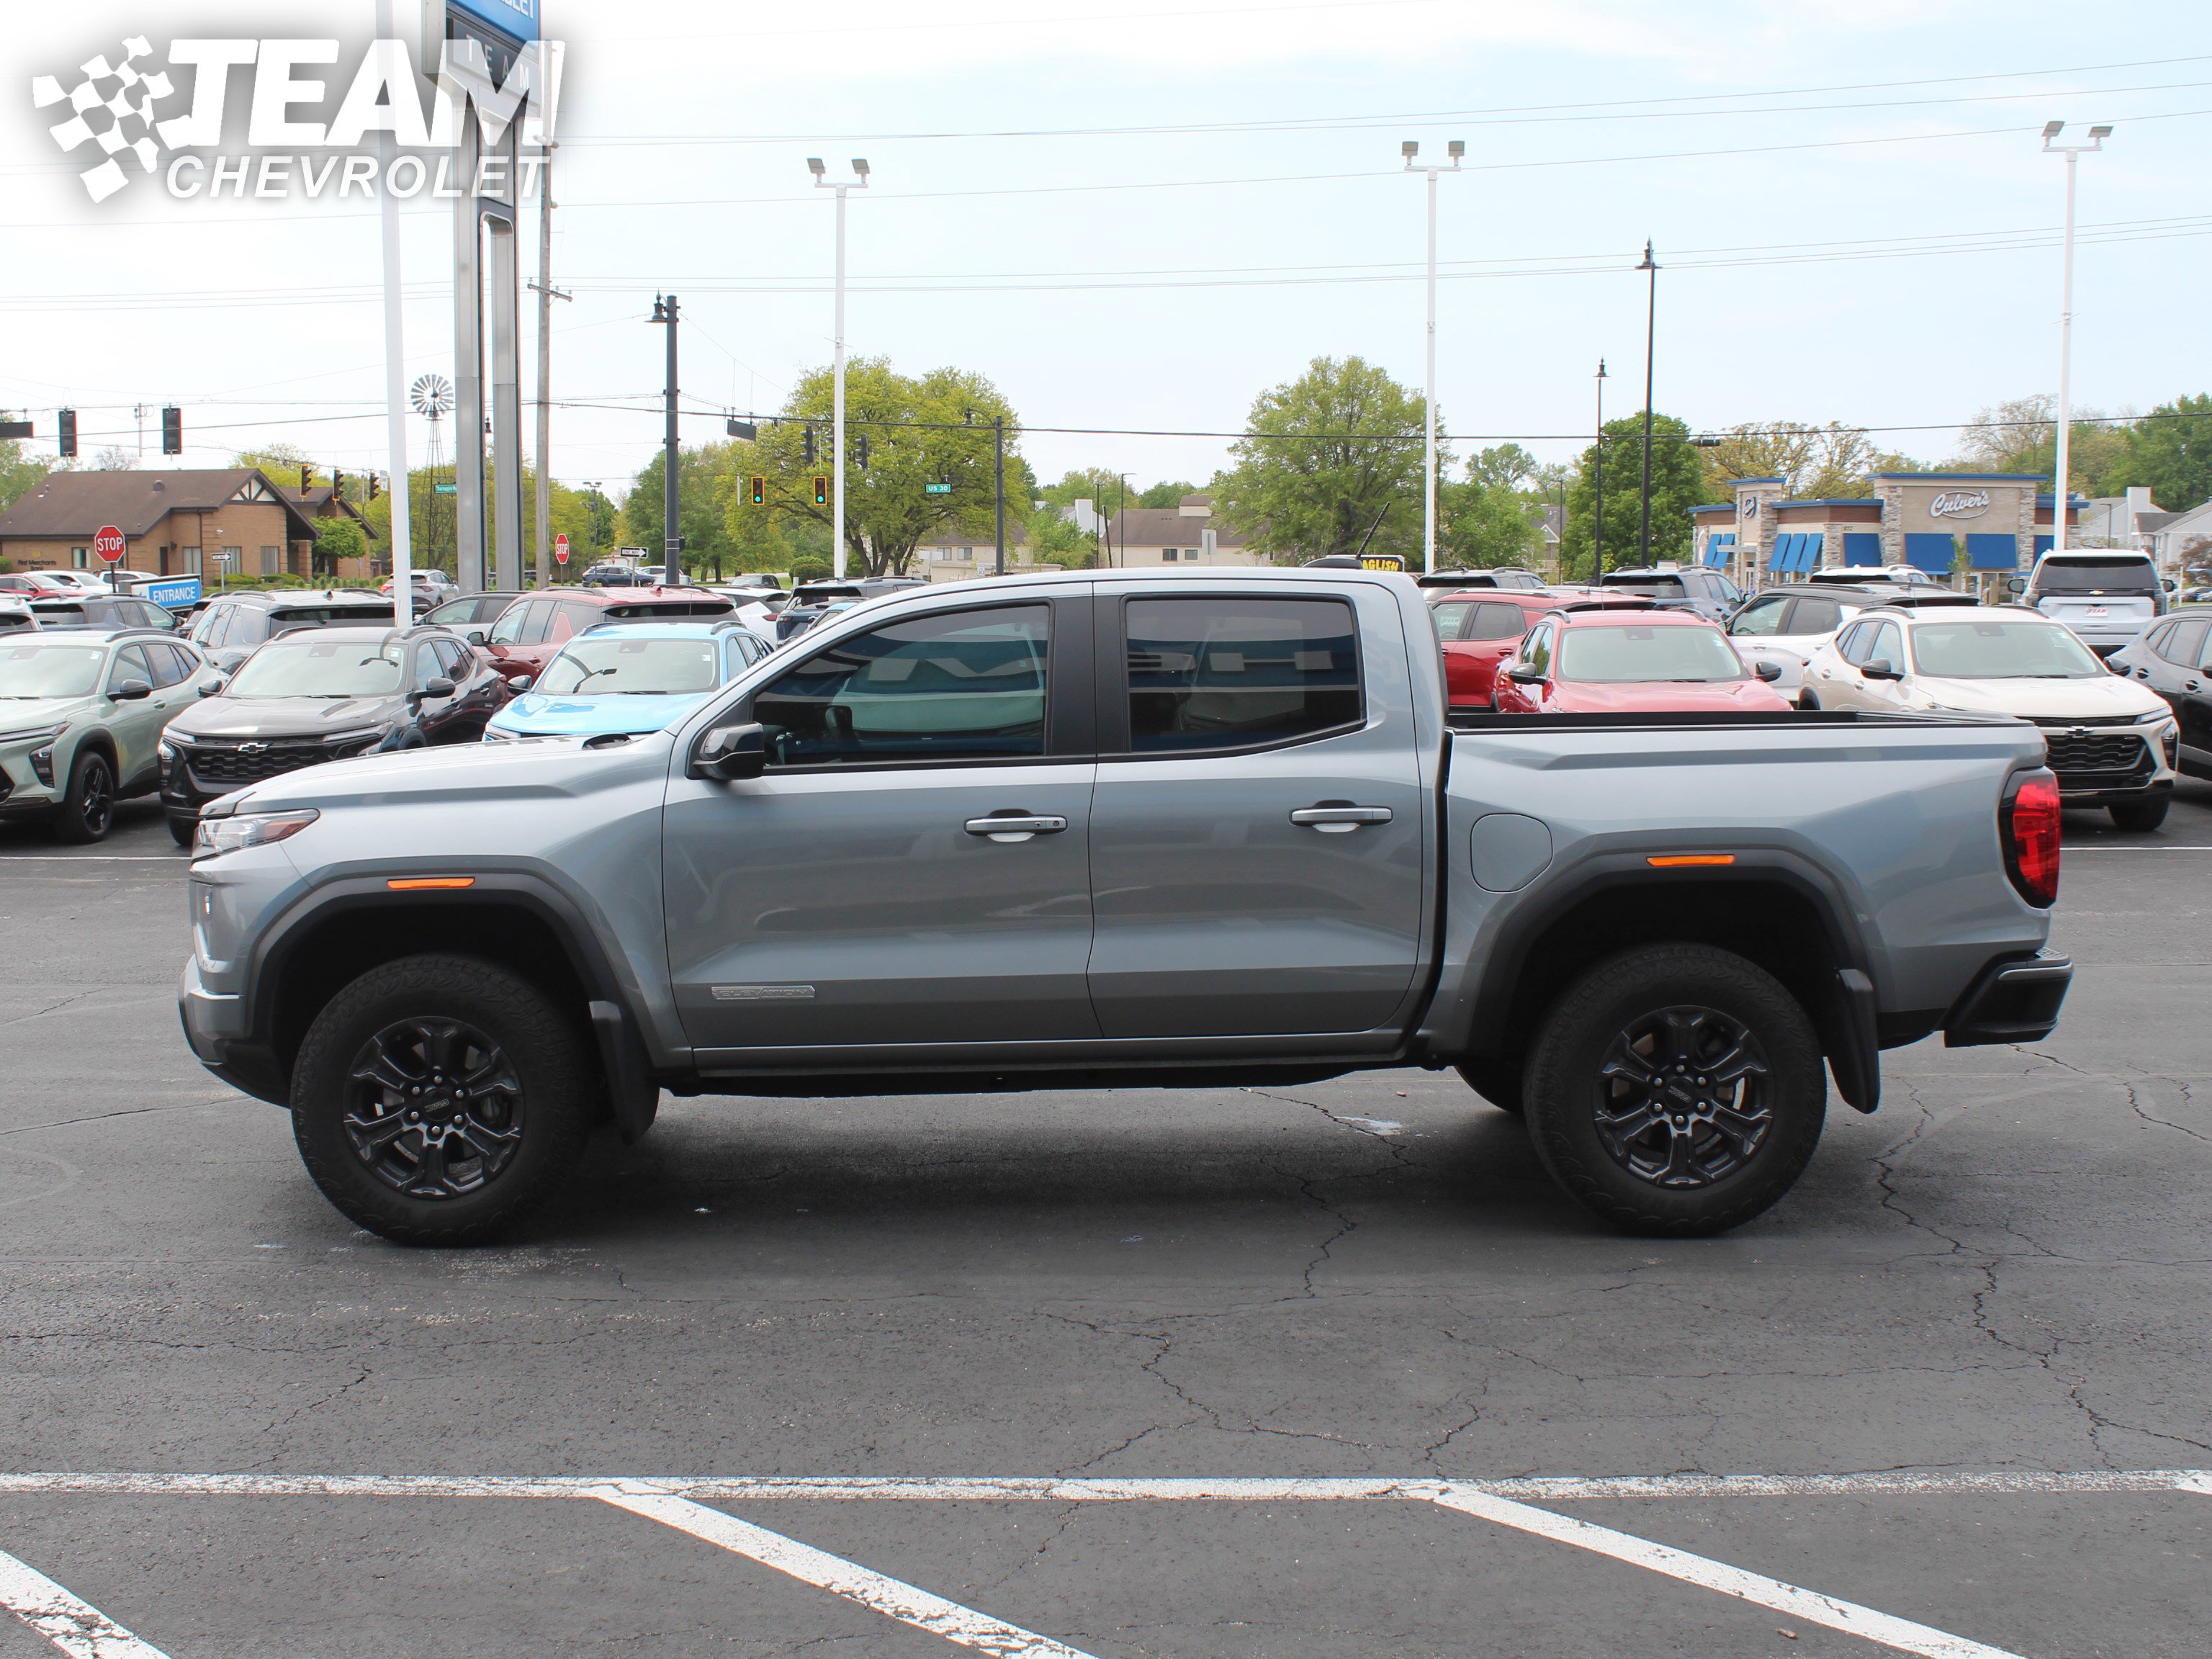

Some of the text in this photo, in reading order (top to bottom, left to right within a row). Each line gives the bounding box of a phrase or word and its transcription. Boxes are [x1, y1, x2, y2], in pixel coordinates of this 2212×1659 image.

[1929, 490, 1990, 518] Culver's
[97, 536, 123, 552] STOP
[557, 544, 568, 554] STOP
[1362, 559, 1399, 572] AGLISH
[153, 586, 196, 603] ENTRANCE
[719, 989, 807, 998] ELEVATION
